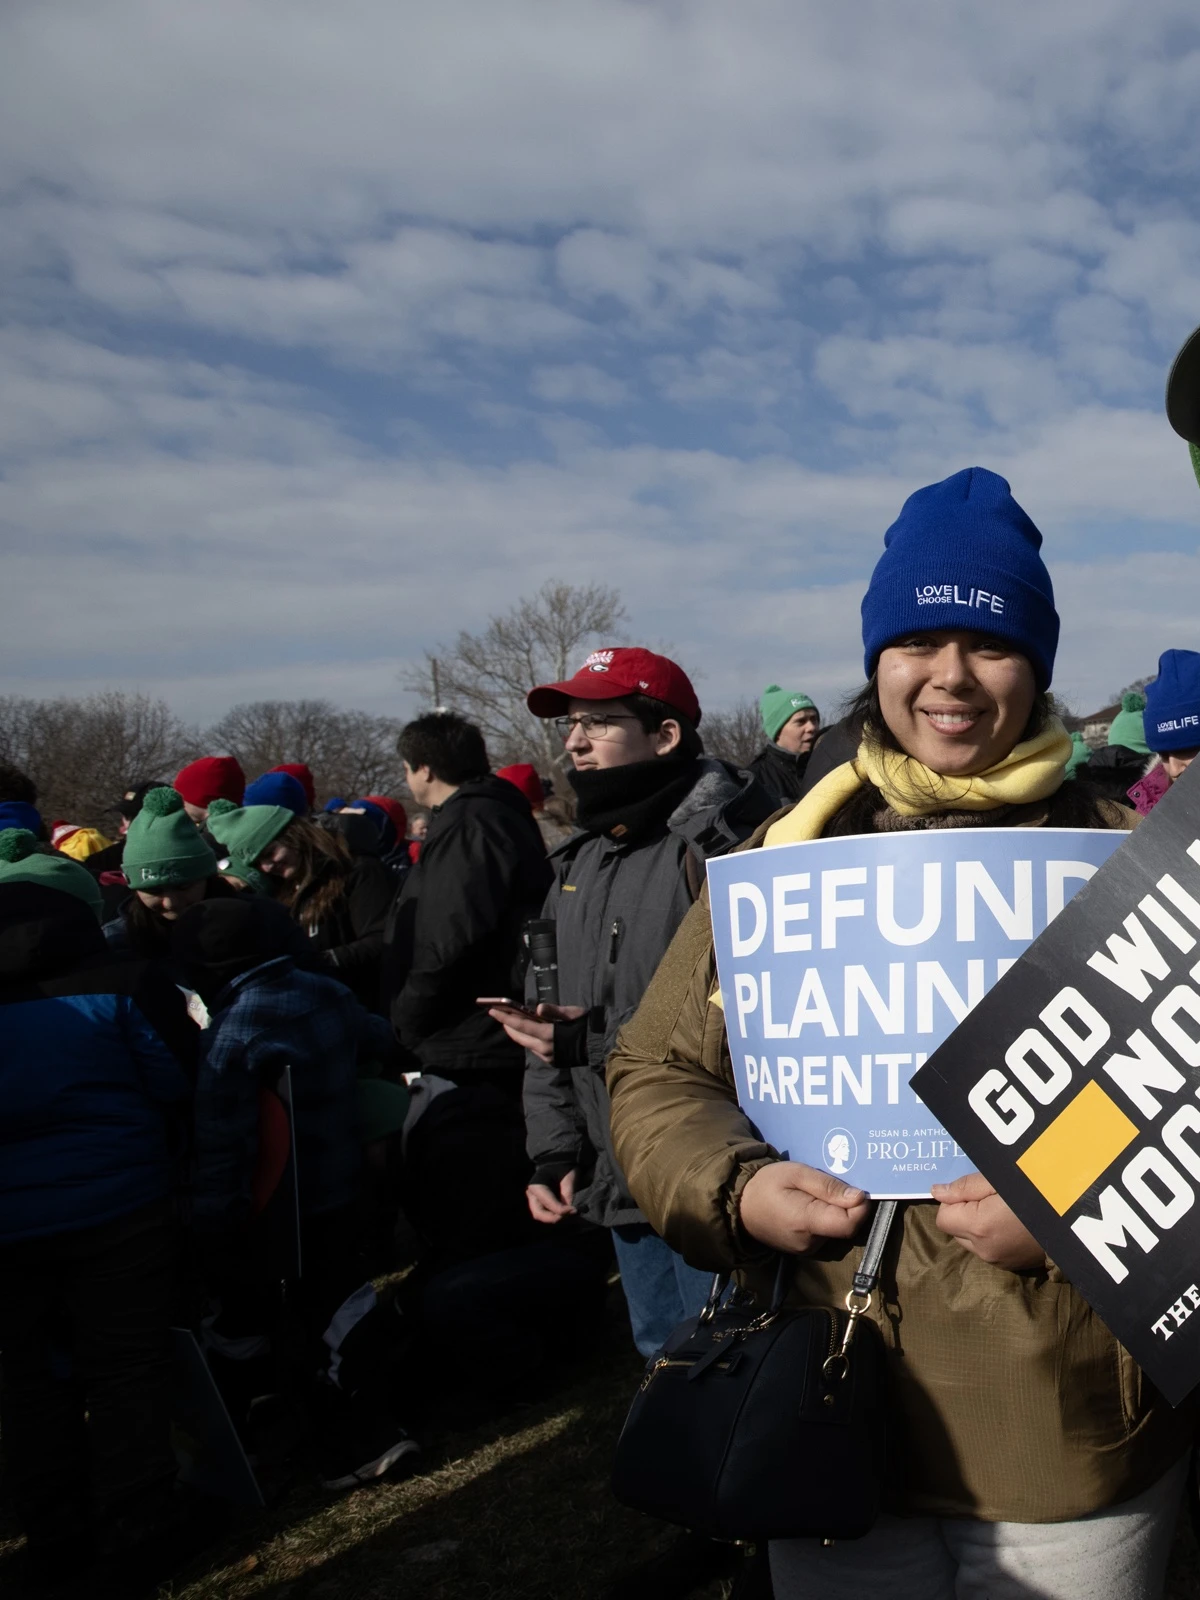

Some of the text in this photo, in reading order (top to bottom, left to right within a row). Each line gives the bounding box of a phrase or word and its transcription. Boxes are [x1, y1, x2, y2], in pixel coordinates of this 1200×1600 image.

[915, 584, 952, 598] LOVE
[917, 596, 952, 605] CHOOSE
[953, 585, 1005, 614] LIFE
[1157, 720, 1173, 729] LOVE
[1174, 715, 1199, 729] LIFE
[734, 958, 1019, 1039] PLANN
[967, 986, 1111, 1146] GOD
[744, 1052, 928, 1106] PARENT
[868, 1128, 950, 1138] SUSAN B. ANTHO
[866, 1140, 968, 1160] PRO-LIFE
[892, 1162, 938, 1172] AMERICA
